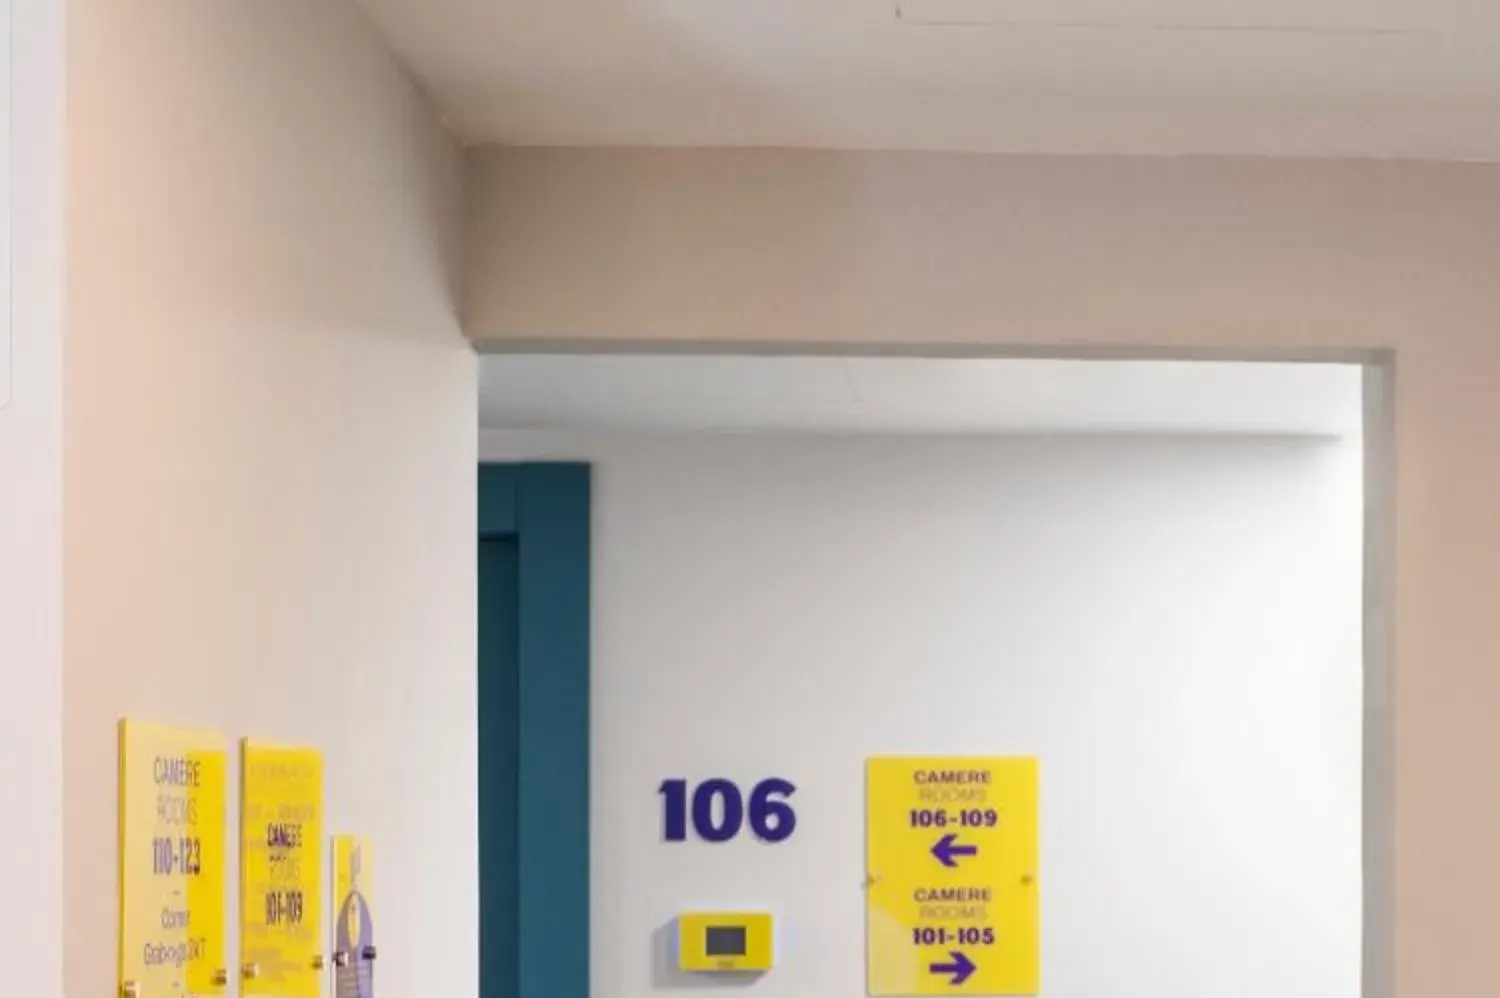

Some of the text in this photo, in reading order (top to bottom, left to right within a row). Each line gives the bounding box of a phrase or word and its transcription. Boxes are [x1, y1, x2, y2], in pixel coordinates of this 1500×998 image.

[913, 770, 992, 784] CAMERE
[658, 777, 796, 843] 106
[910, 809, 997, 827] 106-109
[913, 887, 992, 902] CAMERE
[913, 927, 995, 945] 101-105
